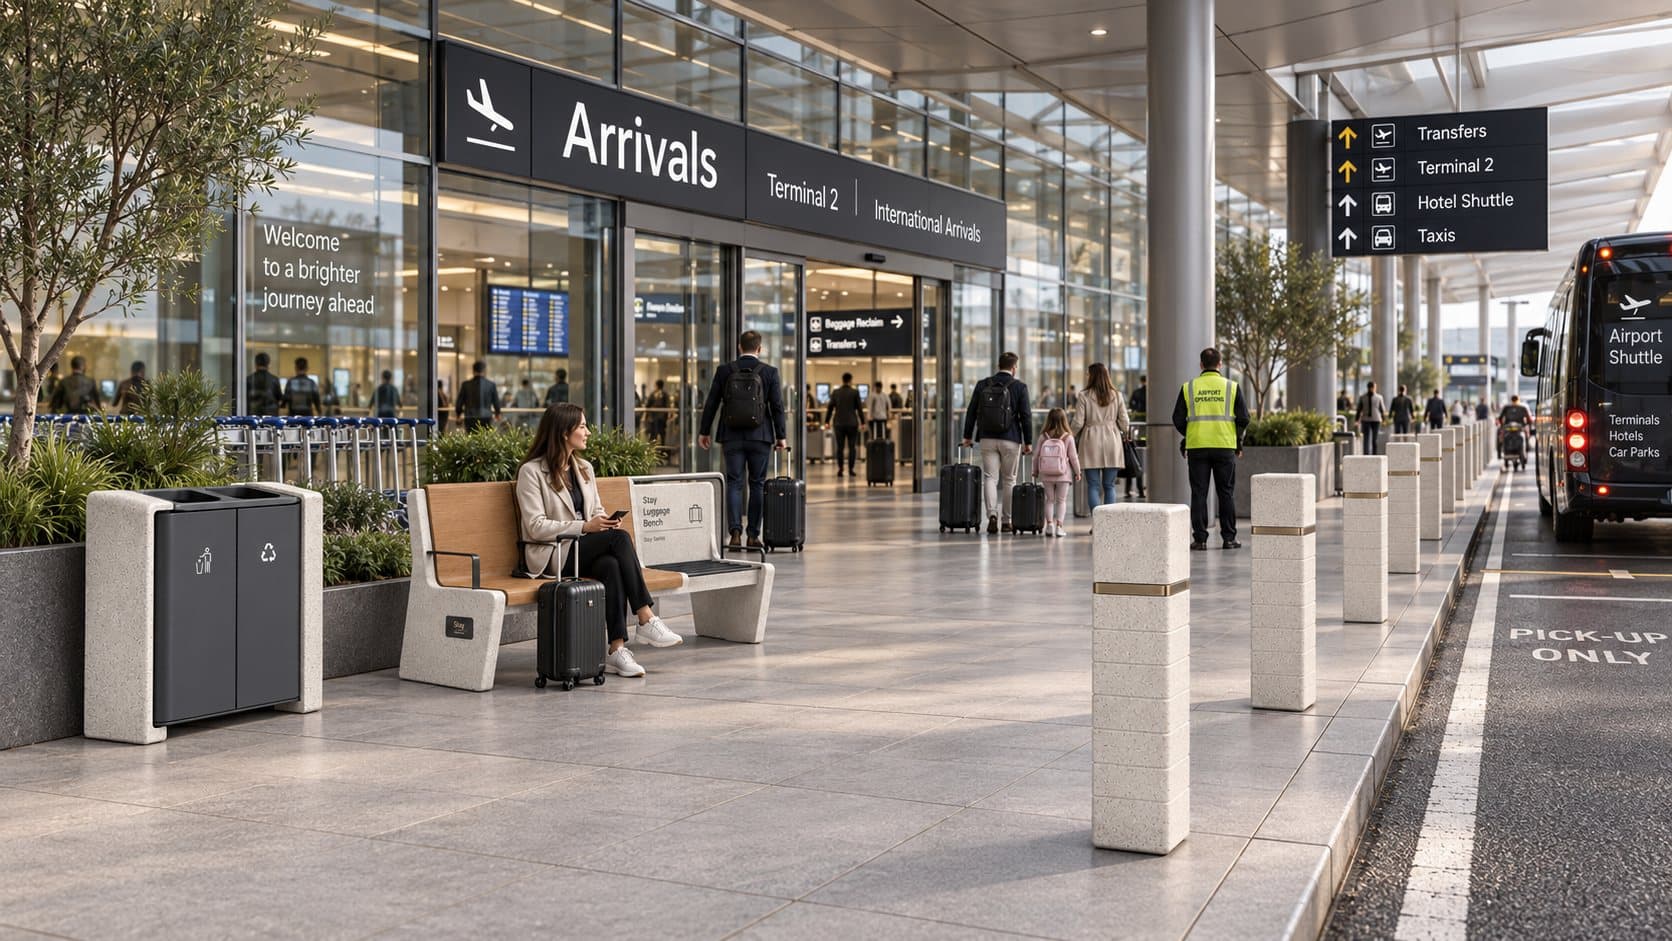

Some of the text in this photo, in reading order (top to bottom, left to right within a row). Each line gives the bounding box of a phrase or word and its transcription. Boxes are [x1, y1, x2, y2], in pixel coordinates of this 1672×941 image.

[1417, 124, 1487, 141] Transfers
[562, 101, 718, 189] Arrivals
[1417, 157, 1494, 175] Terminal 2
[767, 172, 839, 211] Terminal 2
[1418, 191, 1514, 210] Hotel Shuttle
[875, 199, 981, 243] International Arrivals
[263, 223, 340, 252] Welcome
[1417, 228, 1456, 243] Taxis
[263, 257, 360, 286] to a brighter
[262, 286, 374, 316] journey ahead
[825, 318, 855, 331] Baggage
[825, 338, 857, 349] Transfers
[1609, 328, 1663, 346] Airport
[1609, 349, 1663, 365] Shuttle
[1609, 414, 1660, 425] Terminals
[1609, 430, 1644, 442] Hotels
[1609, 446, 1660, 458] Car Parks
[642, 496, 657, 505] Stay
[643, 507, 670, 518] Luggage
[643, 518, 663, 528] Bench
[1510, 628, 1668, 644] PICK-UP
[1532, 648, 1651, 665] ONLY
